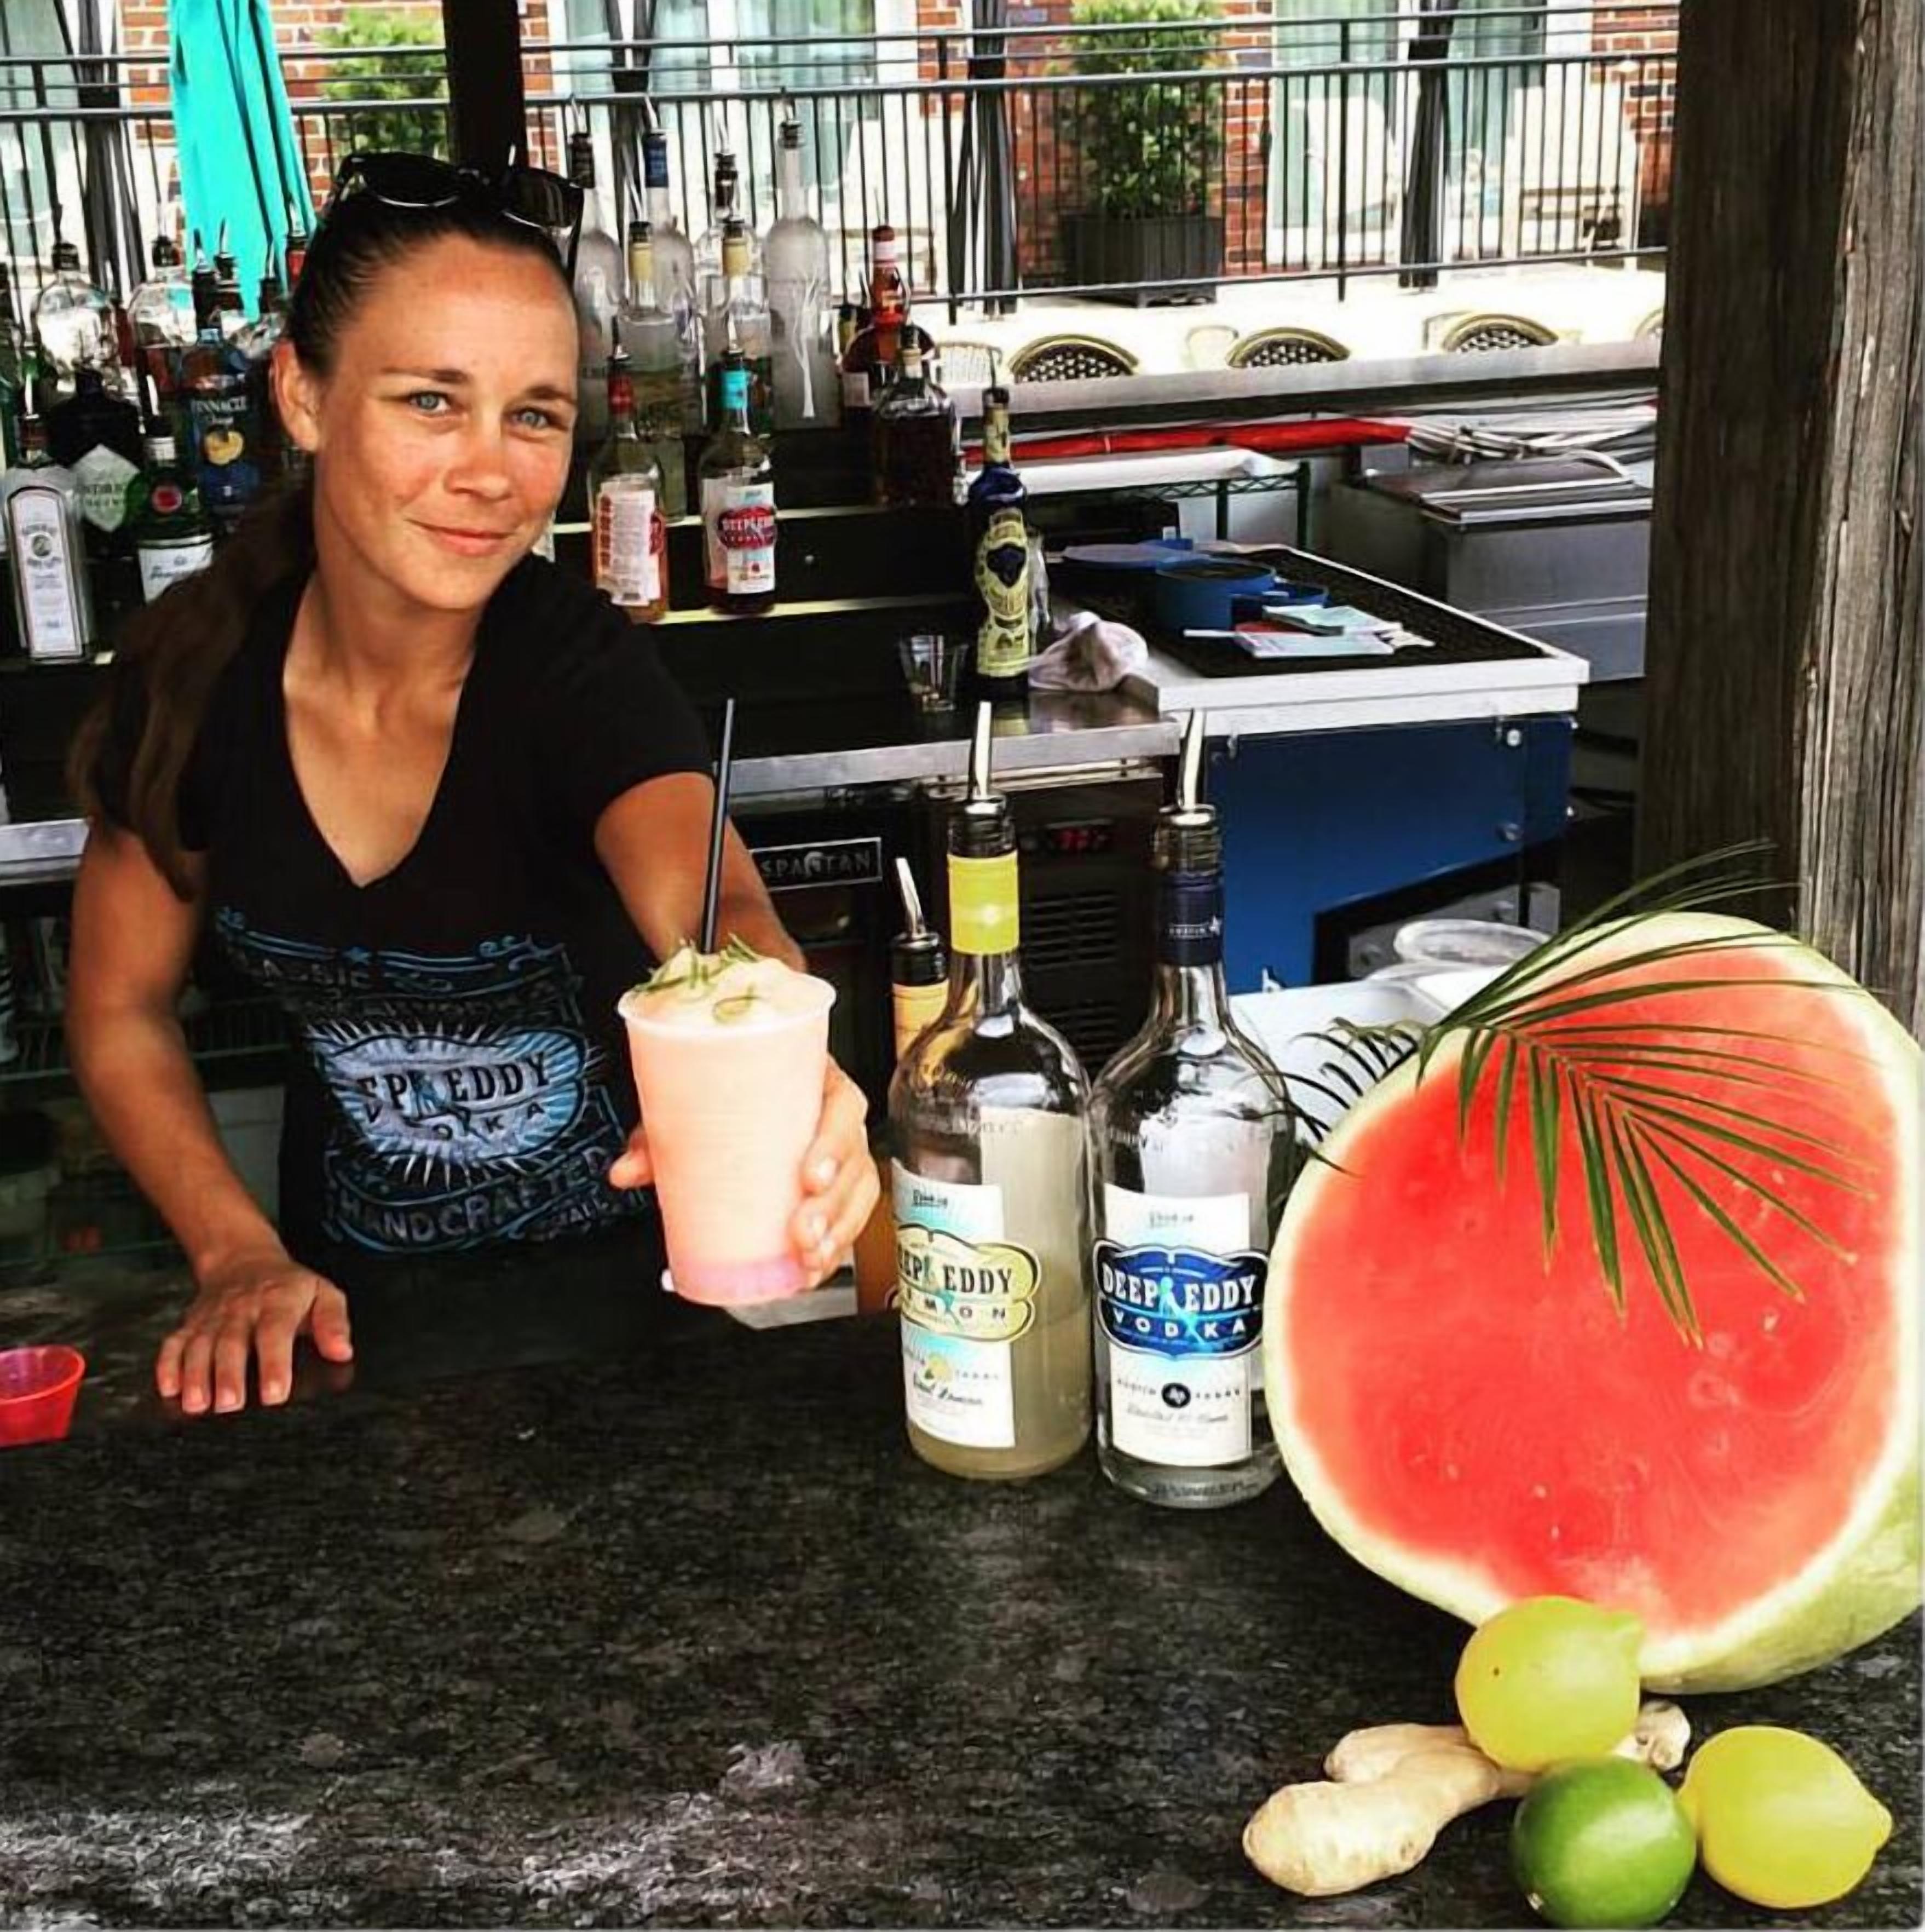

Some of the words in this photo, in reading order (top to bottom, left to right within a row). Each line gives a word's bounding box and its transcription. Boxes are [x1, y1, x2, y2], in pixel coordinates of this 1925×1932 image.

[443, 1051, 549, 1102] EDDY
[943, 1263, 1012, 1294] EDDY
[1102, 1262, 1159, 1309] DEEP
[1183, 1274, 1257, 1312] EDDY
[1113, 1308, 1247, 1339] VODKA
